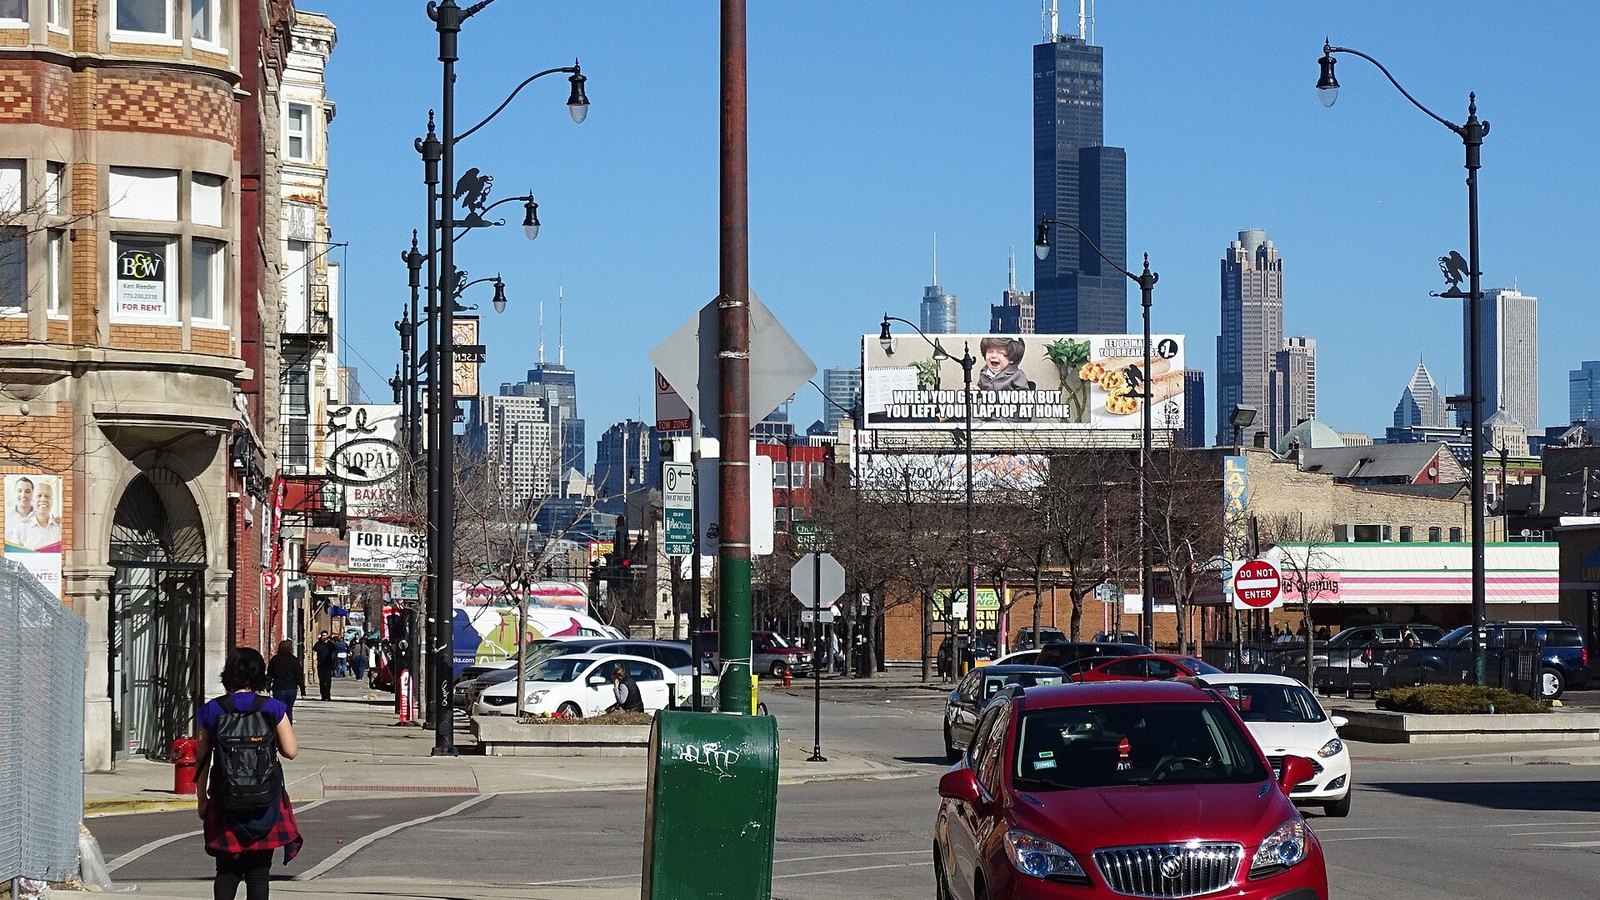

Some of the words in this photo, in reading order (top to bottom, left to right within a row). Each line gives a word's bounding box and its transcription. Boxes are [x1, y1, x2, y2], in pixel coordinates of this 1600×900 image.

[122, 253, 160, 278] B&W
[121, 303, 138, 311] FOR
[140, 304, 162, 312] RENT
[1105, 338, 1119, 348] LET
[1119, 338, 1130, 348] US
[1130, 338, 1153, 348] MAE
[1099, 347, 1115, 358] YOU
[1116, 347, 1159, 358] BREAKFST
[892, 390, 929, 405] WHEN
[930, 390, 955, 405] YOU
[979, 390, 997, 405] TO
[999, 390, 1036, 405] WORK
[1036, 390, 1062, 405] BUT
[885, 404, 910, 419] YOU
[911, 404, 937, 419] LEFT
[939, 404, 972, 419] YOU
[972, 404, 1018, 419] LAPTOP
[1019, 404, 1034, 419] AT
[1035, 404, 1070, 419] HOME
[327, 407, 378, 438] El
[658, 421, 671, 430] TOW
[672, 419, 689, 429] ZONE
[342, 452, 398, 470] NOPAL
[356, 532, 383, 547] FOR
[1240, 570, 1251, 578] DO
[1256, 569, 1274, 577] NOT
[1244, 590, 1272, 599] ENTER
